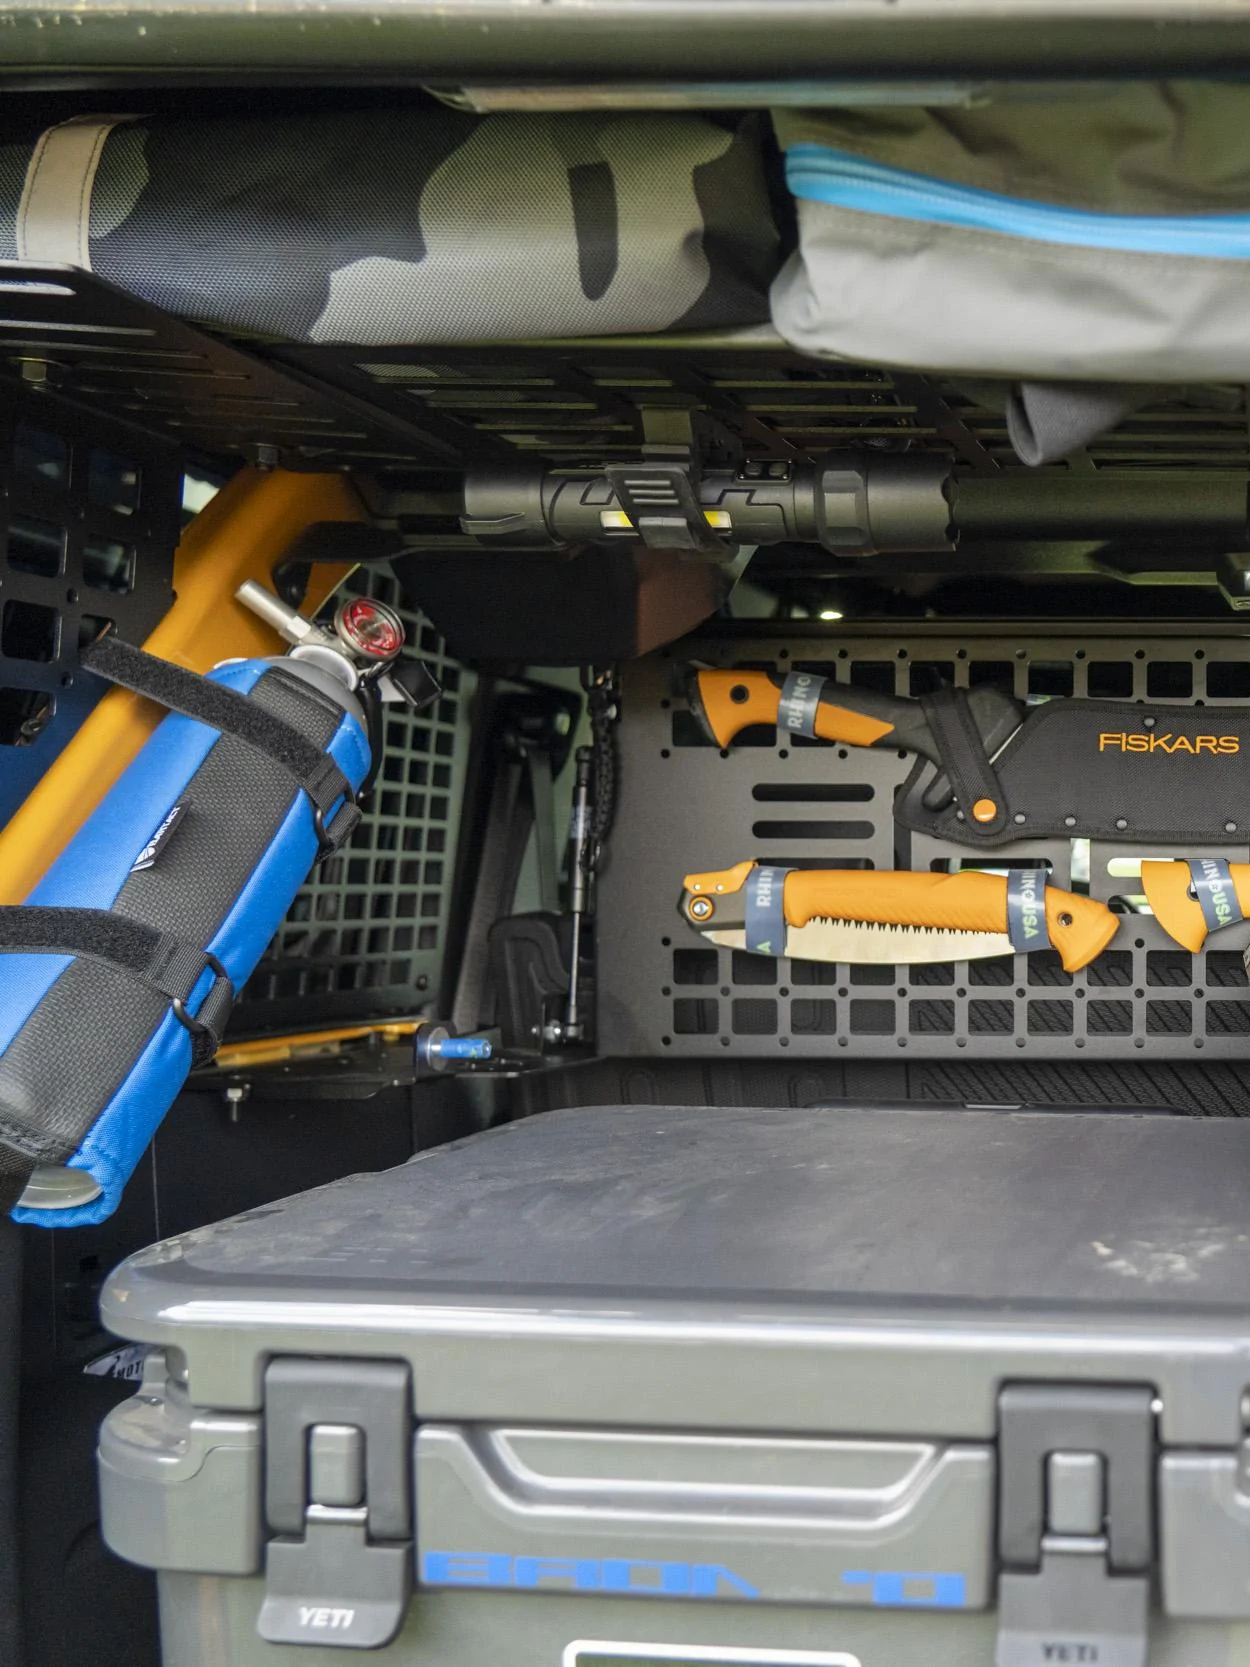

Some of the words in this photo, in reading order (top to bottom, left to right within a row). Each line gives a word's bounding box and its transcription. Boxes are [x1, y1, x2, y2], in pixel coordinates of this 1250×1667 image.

[1099, 732, 1241, 755] FISKARS
[423, 1551, 967, 1606] BRONO
[298, 1606, 356, 1630] YETI
